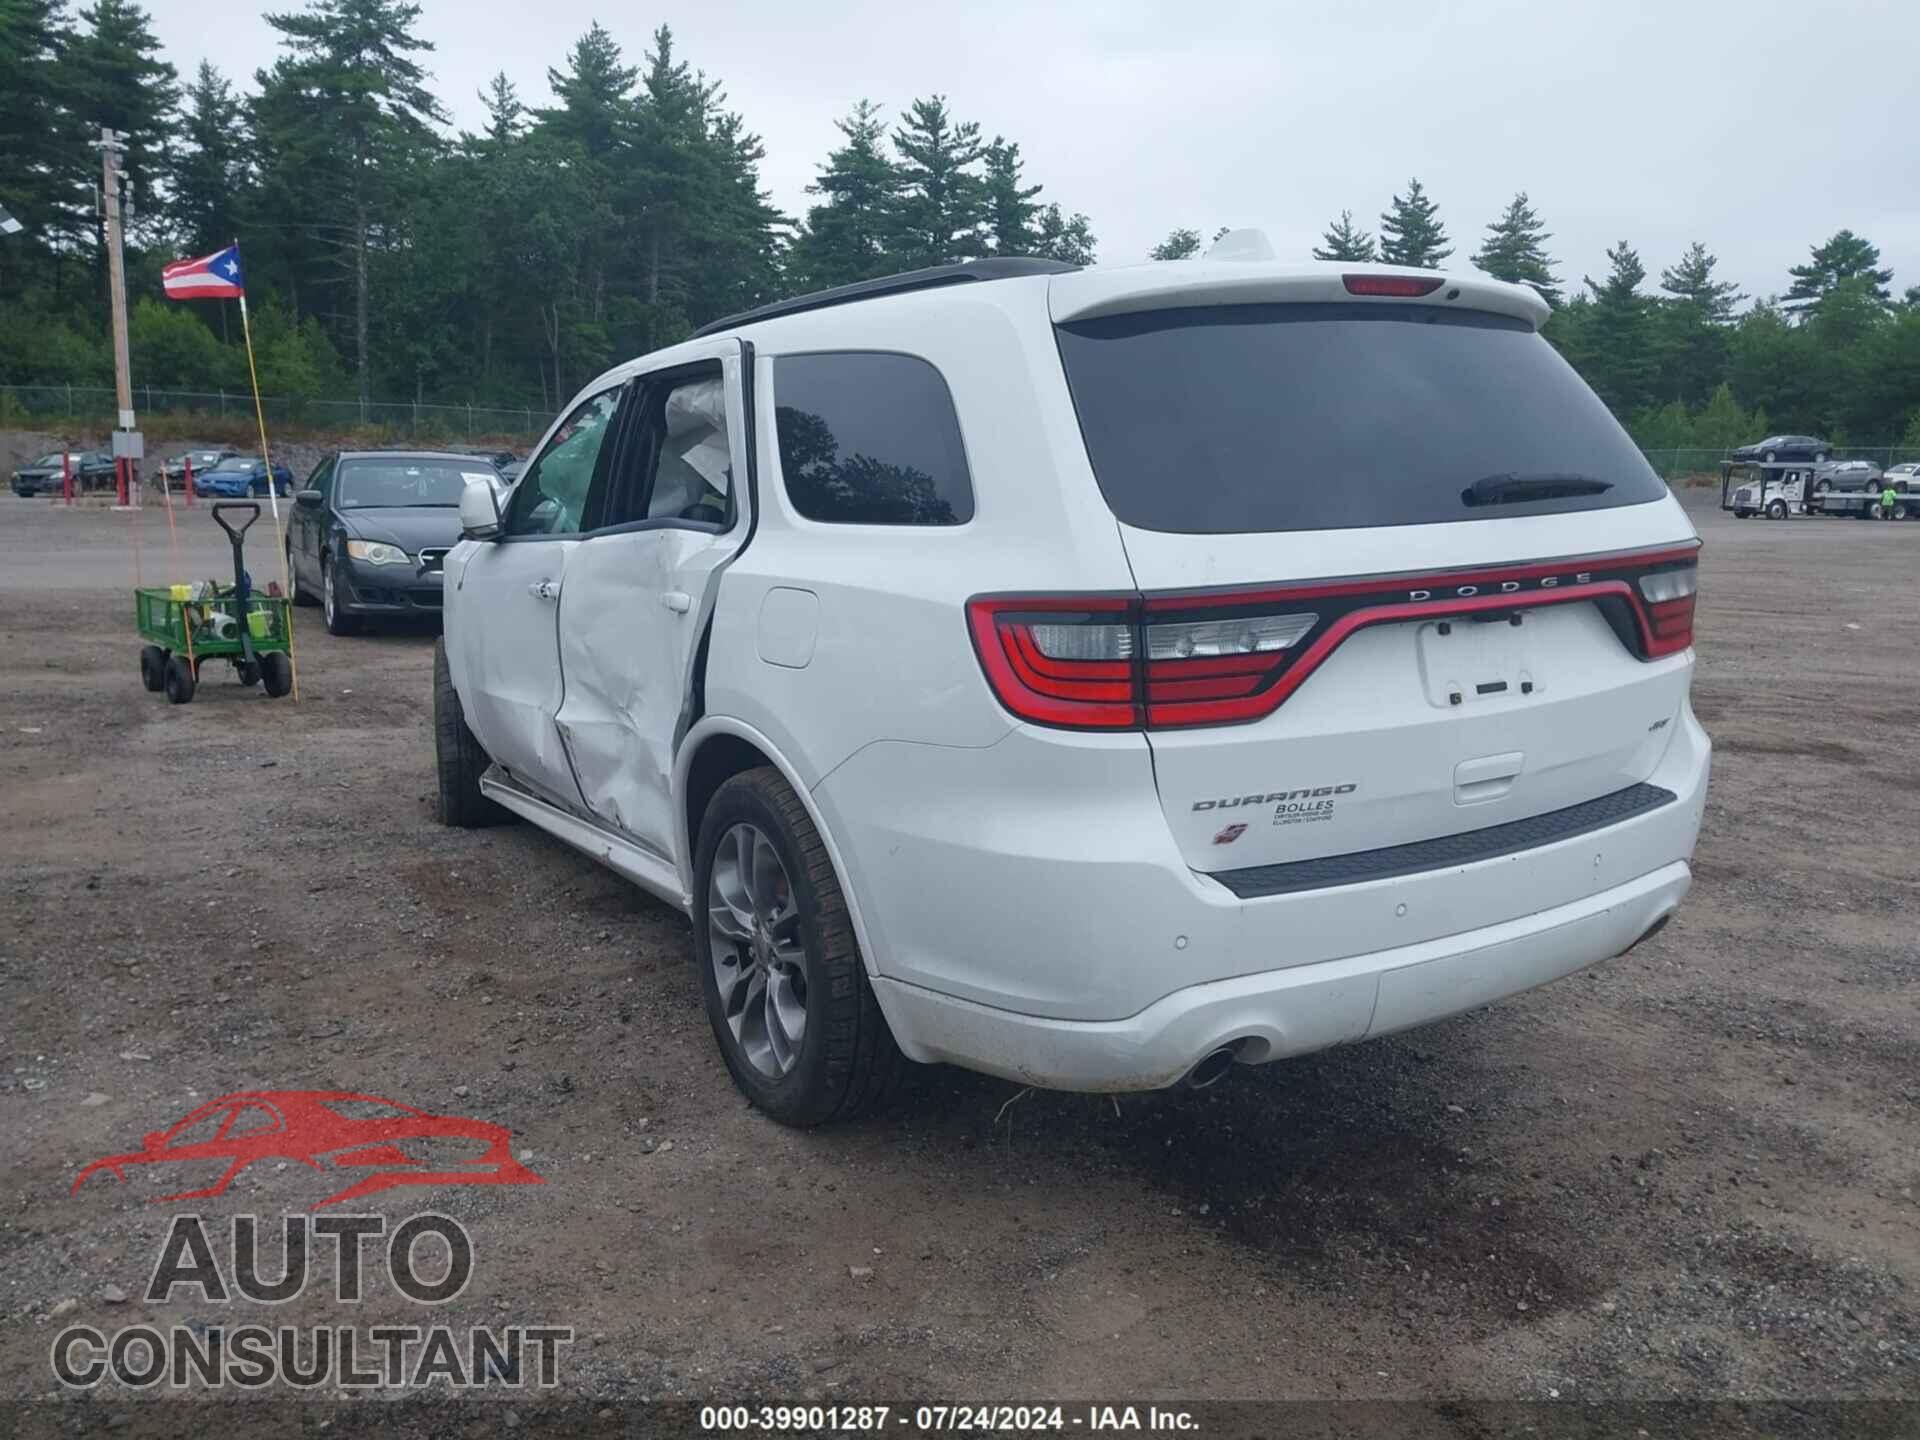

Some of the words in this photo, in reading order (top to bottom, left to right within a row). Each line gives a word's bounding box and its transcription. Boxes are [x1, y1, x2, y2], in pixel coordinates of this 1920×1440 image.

[1409, 572, 1591, 602] DODGE
[1191, 783, 1357, 812] DURANGO
[1275, 800, 1334, 814] BOLLES
